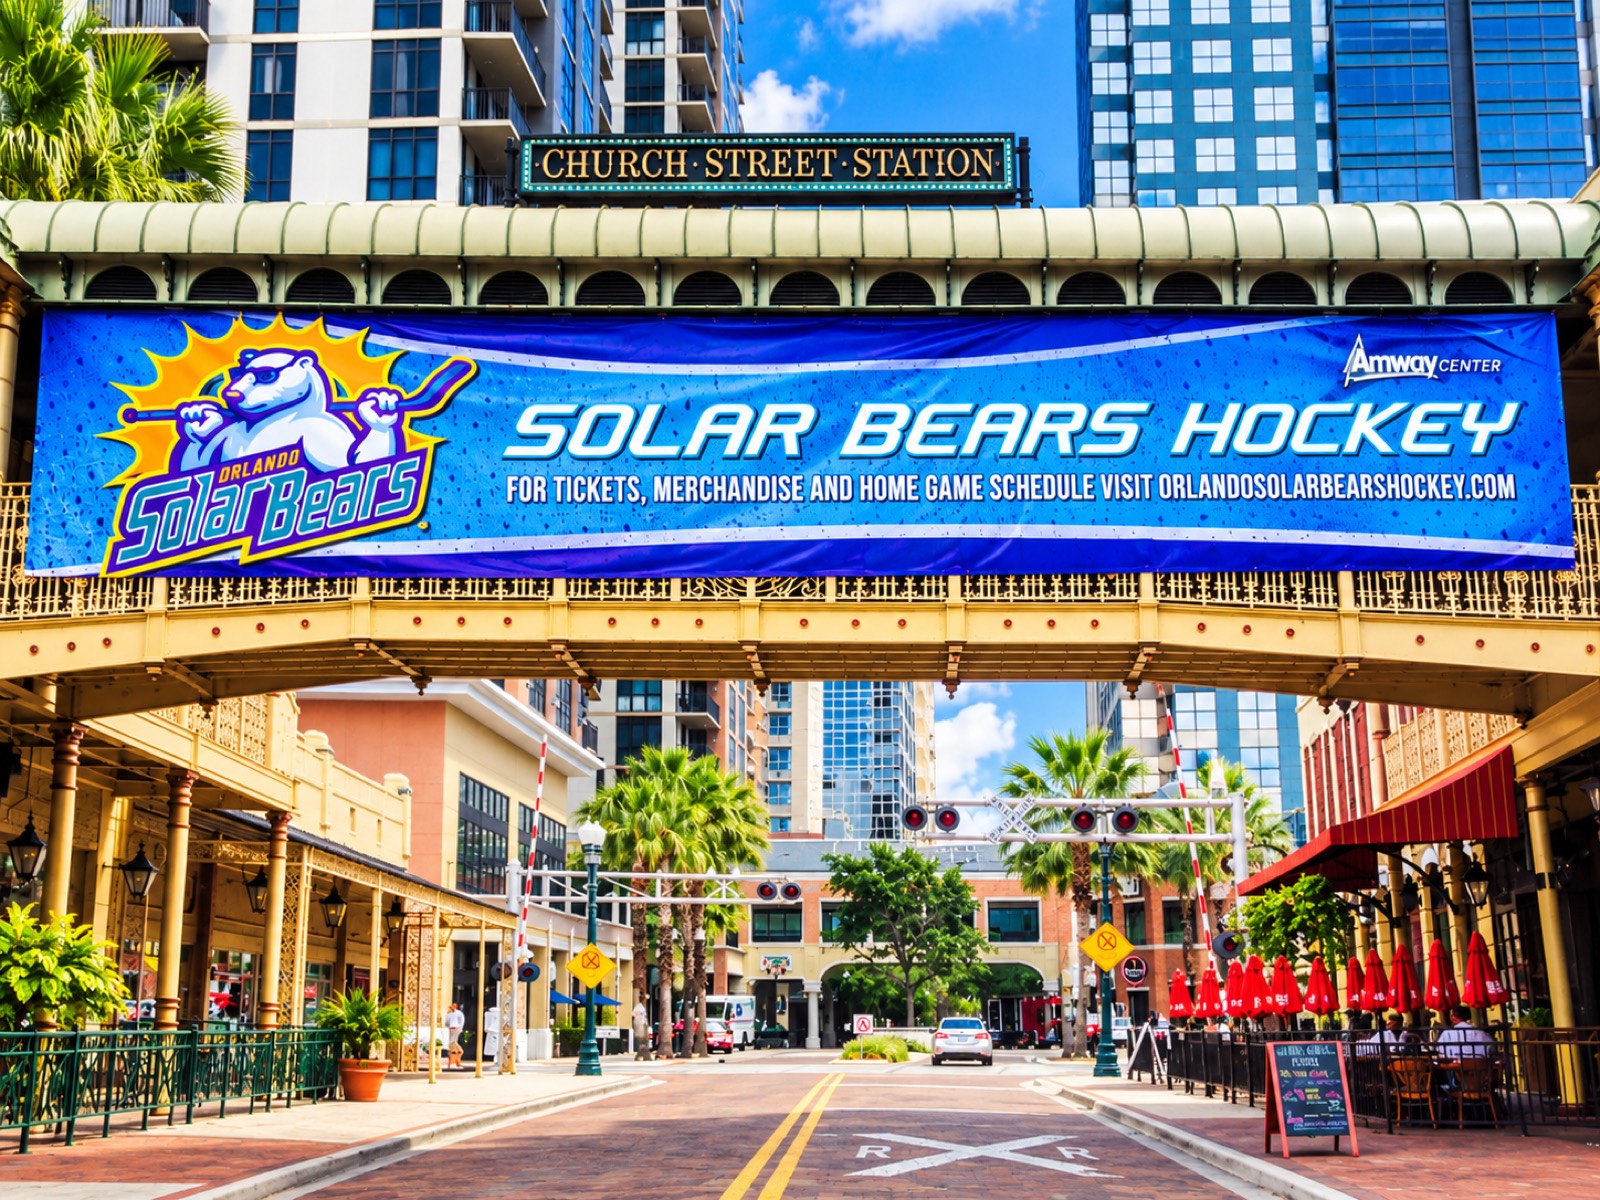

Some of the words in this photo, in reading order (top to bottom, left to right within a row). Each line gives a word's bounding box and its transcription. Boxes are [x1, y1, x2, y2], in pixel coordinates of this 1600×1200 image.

[541, 148, 689, 179] CHURCH
[704, 147, 837, 178] STREET
[852, 146, 995, 178] STATION
[1345, 341, 1438, 381] Amway
[1438, 358, 1502, 373] CENTER
[502, 402, 819, 459] SOLAR
[839, 402, 1151, 458] BEARS
[1170, 401, 1521, 457] HOCKEY
[217, 448, 300, 484] ORLANDO
[506, 475, 548, 503] FOR
[552, 475, 647, 506] TICKETS,
[653, 474, 805, 503] MERCHANDISE
[809, 474, 853, 502] AND
[859, 474, 920, 501] HOME
[925, 473, 984, 501] GAME
[988, 473, 1095, 501] SCHEDULE
[1100, 473, 1154, 500] VISIT
[1157, 472, 1517, 500] ORLANDOSOLARBEARSHOCKEY.COM
[855, 1145, 891, 1159] R
